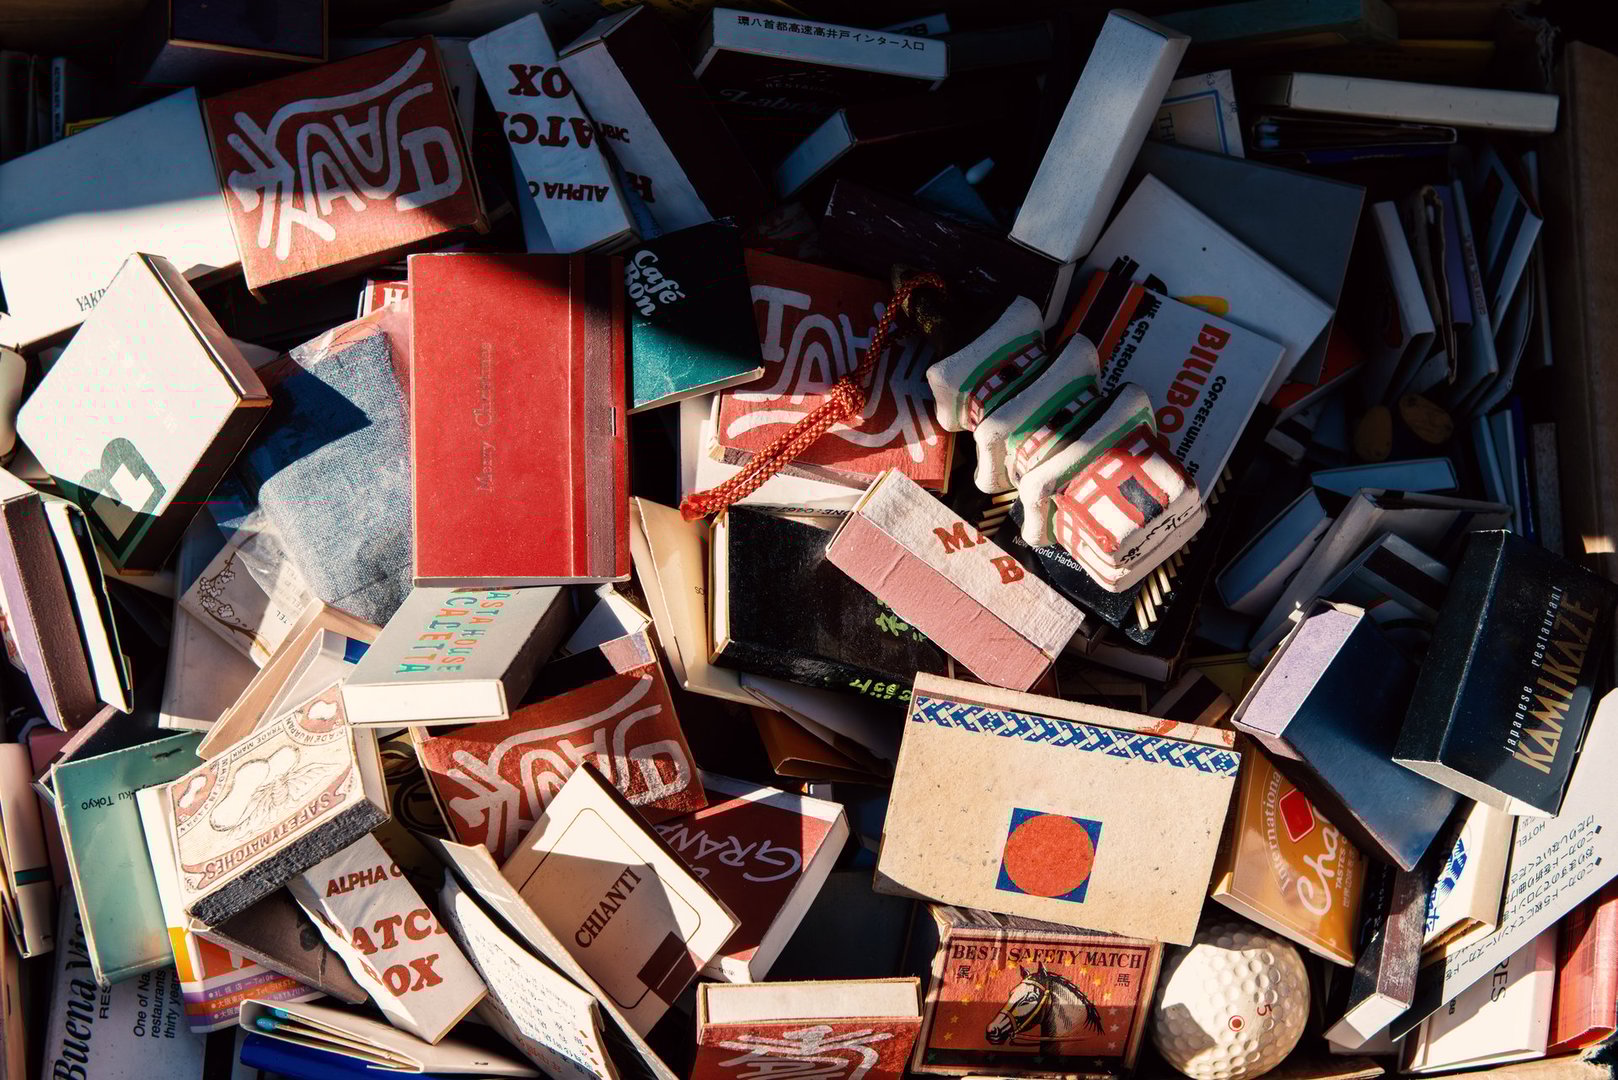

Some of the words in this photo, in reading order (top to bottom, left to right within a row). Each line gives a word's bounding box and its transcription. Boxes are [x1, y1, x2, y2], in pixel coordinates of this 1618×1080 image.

[544, 182, 609, 202] ALPHA
[635, 250, 686, 304] Café
[1130, 321, 1150, 344] GET
[472, 342, 494, 427] Christmas
[475, 440, 495, 493] Merry
[1032, 543, 1055, 558] World
[1054, 553, 1083, 572] Harbour
[275, 610, 289, 624] TEL
[436, 629, 479, 673] HOUSE
[1502, 685, 1533, 754] japanese
[1530, 586, 1563, 667] restaurant
[1512, 591, 1600, 771] KAMIKAZE
[81, 796, 114, 810] Tokyo
[1516, 819, 1548, 847] HOTEL
[326, 866, 388, 897] ALPHA
[1336, 848, 1346, 889] TASTES
[573, 866, 642, 949] CHIANTI
[952, 945, 1001, 960] BEST
[1007, 947, 1082, 966] SAFETY
[1083, 951, 1143, 969] MATCH
[1116, 973, 1130, 987] 馬
[137, 994, 148, 1007] of
[151, 970, 166, 1038] restaurants
[53, 980, 96, 1080] Buena
[134, 1011, 146, 1037] One
[164, 1008, 179, 1038] thirty
